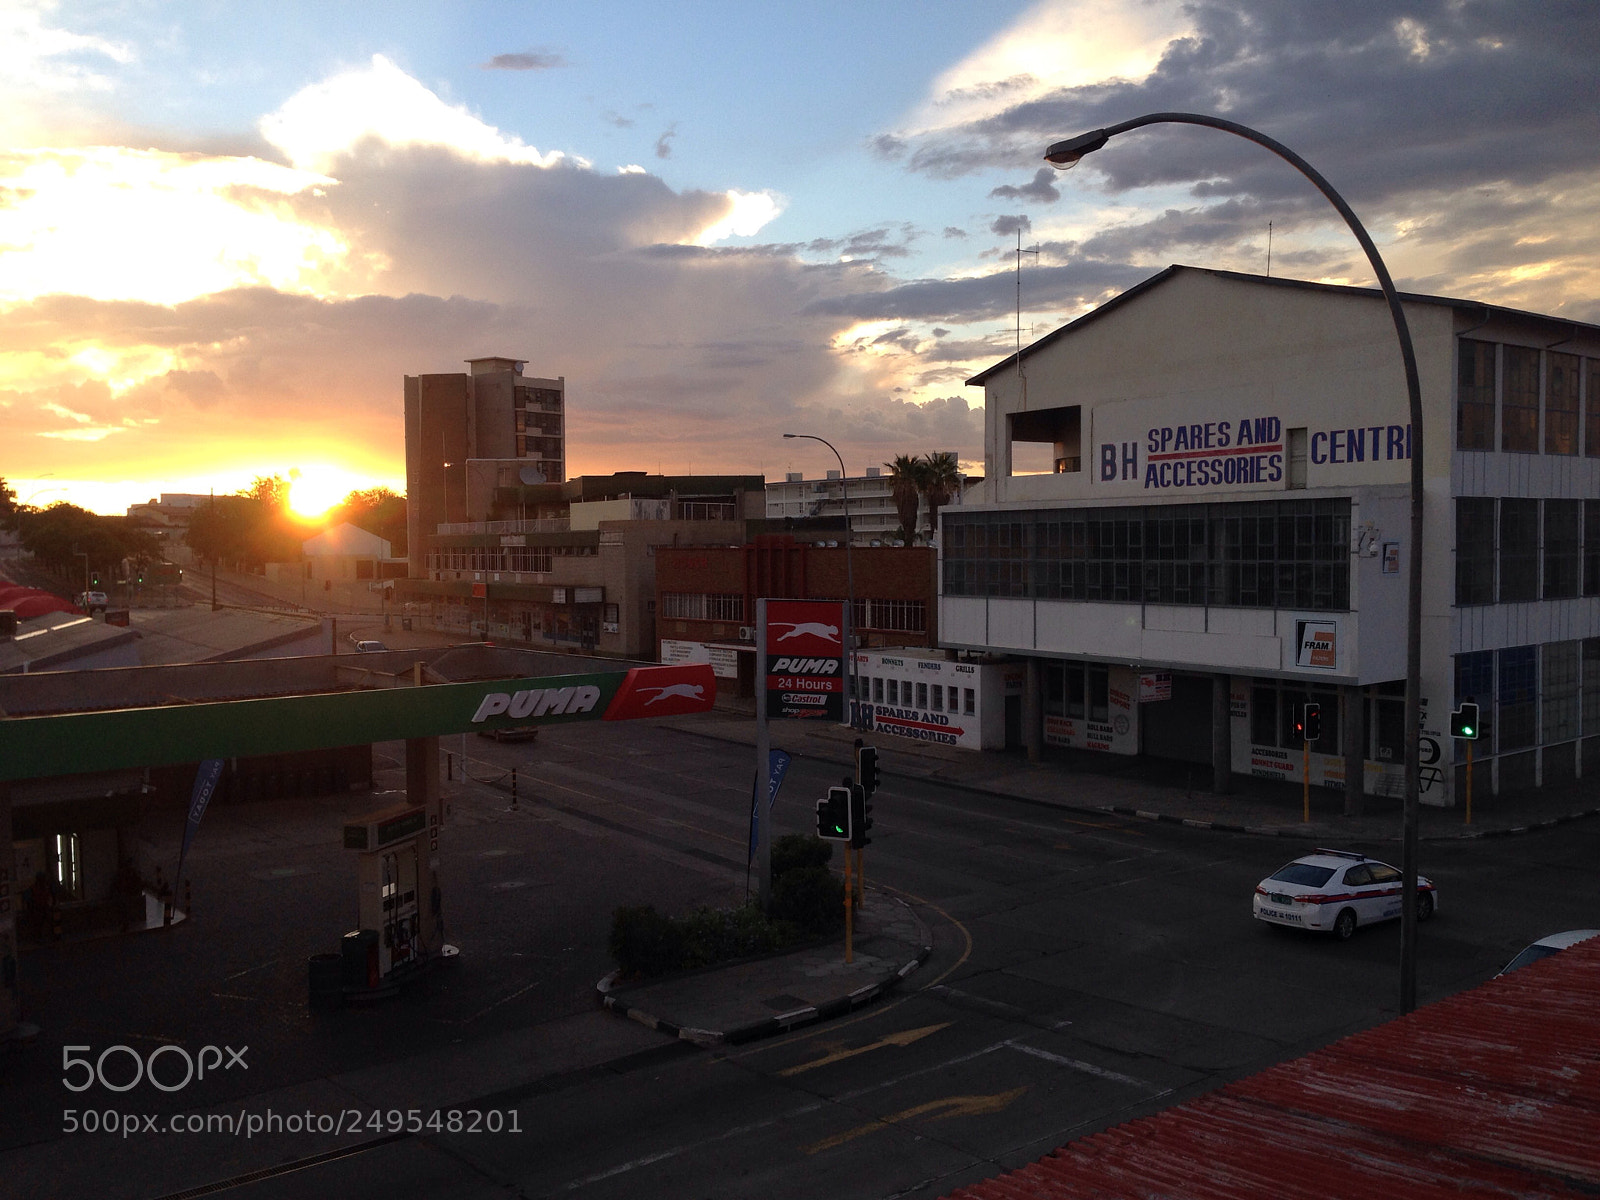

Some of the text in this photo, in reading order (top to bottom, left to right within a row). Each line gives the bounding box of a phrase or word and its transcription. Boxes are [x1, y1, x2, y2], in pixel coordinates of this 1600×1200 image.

[1148, 416, 1281, 452] SPARES AND
[1101, 442, 1137, 482] BH
[1144, 454, 1282, 488] ACCESSORIES
[1304, 641, 1329, 650] FRAM
[771, 657, 839, 674] PUMA
[881, 657, 904, 667] BONNETS
[955, 665, 975, 674] GRILLS
[778, 677, 833, 690] 24 Hours
[471, 685, 601, 723] PUMA
[791, 695, 821, 703] Castrol
[876, 705, 948, 726] SPARES AND
[876, 722, 957, 746] ACCESSORIES
[1251, 748, 1288, 759] ACCESSORIES
[1260, 907, 1277, 918] POLICE
[1285, 912, 1302, 921] 10111
